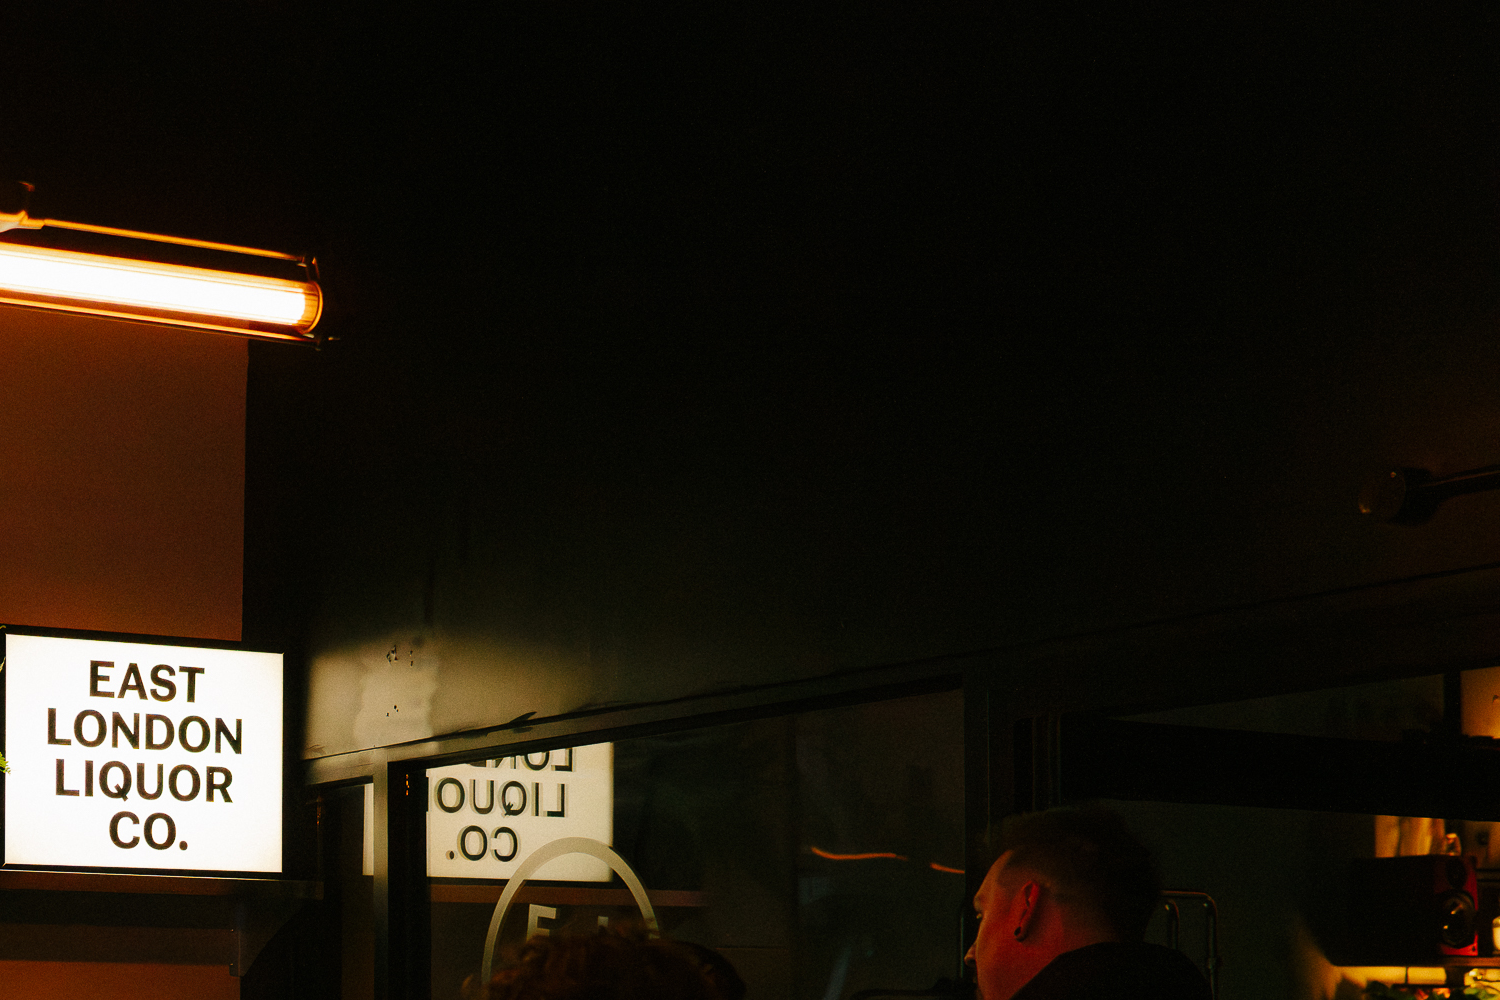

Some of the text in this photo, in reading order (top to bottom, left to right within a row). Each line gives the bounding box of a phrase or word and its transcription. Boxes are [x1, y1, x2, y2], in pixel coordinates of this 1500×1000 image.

[90, 660, 205, 702] EAST
[47, 707, 242, 754] LONDON
[55, 758, 233, 803] LIQUOR
[108, 811, 188, 851] CO.
